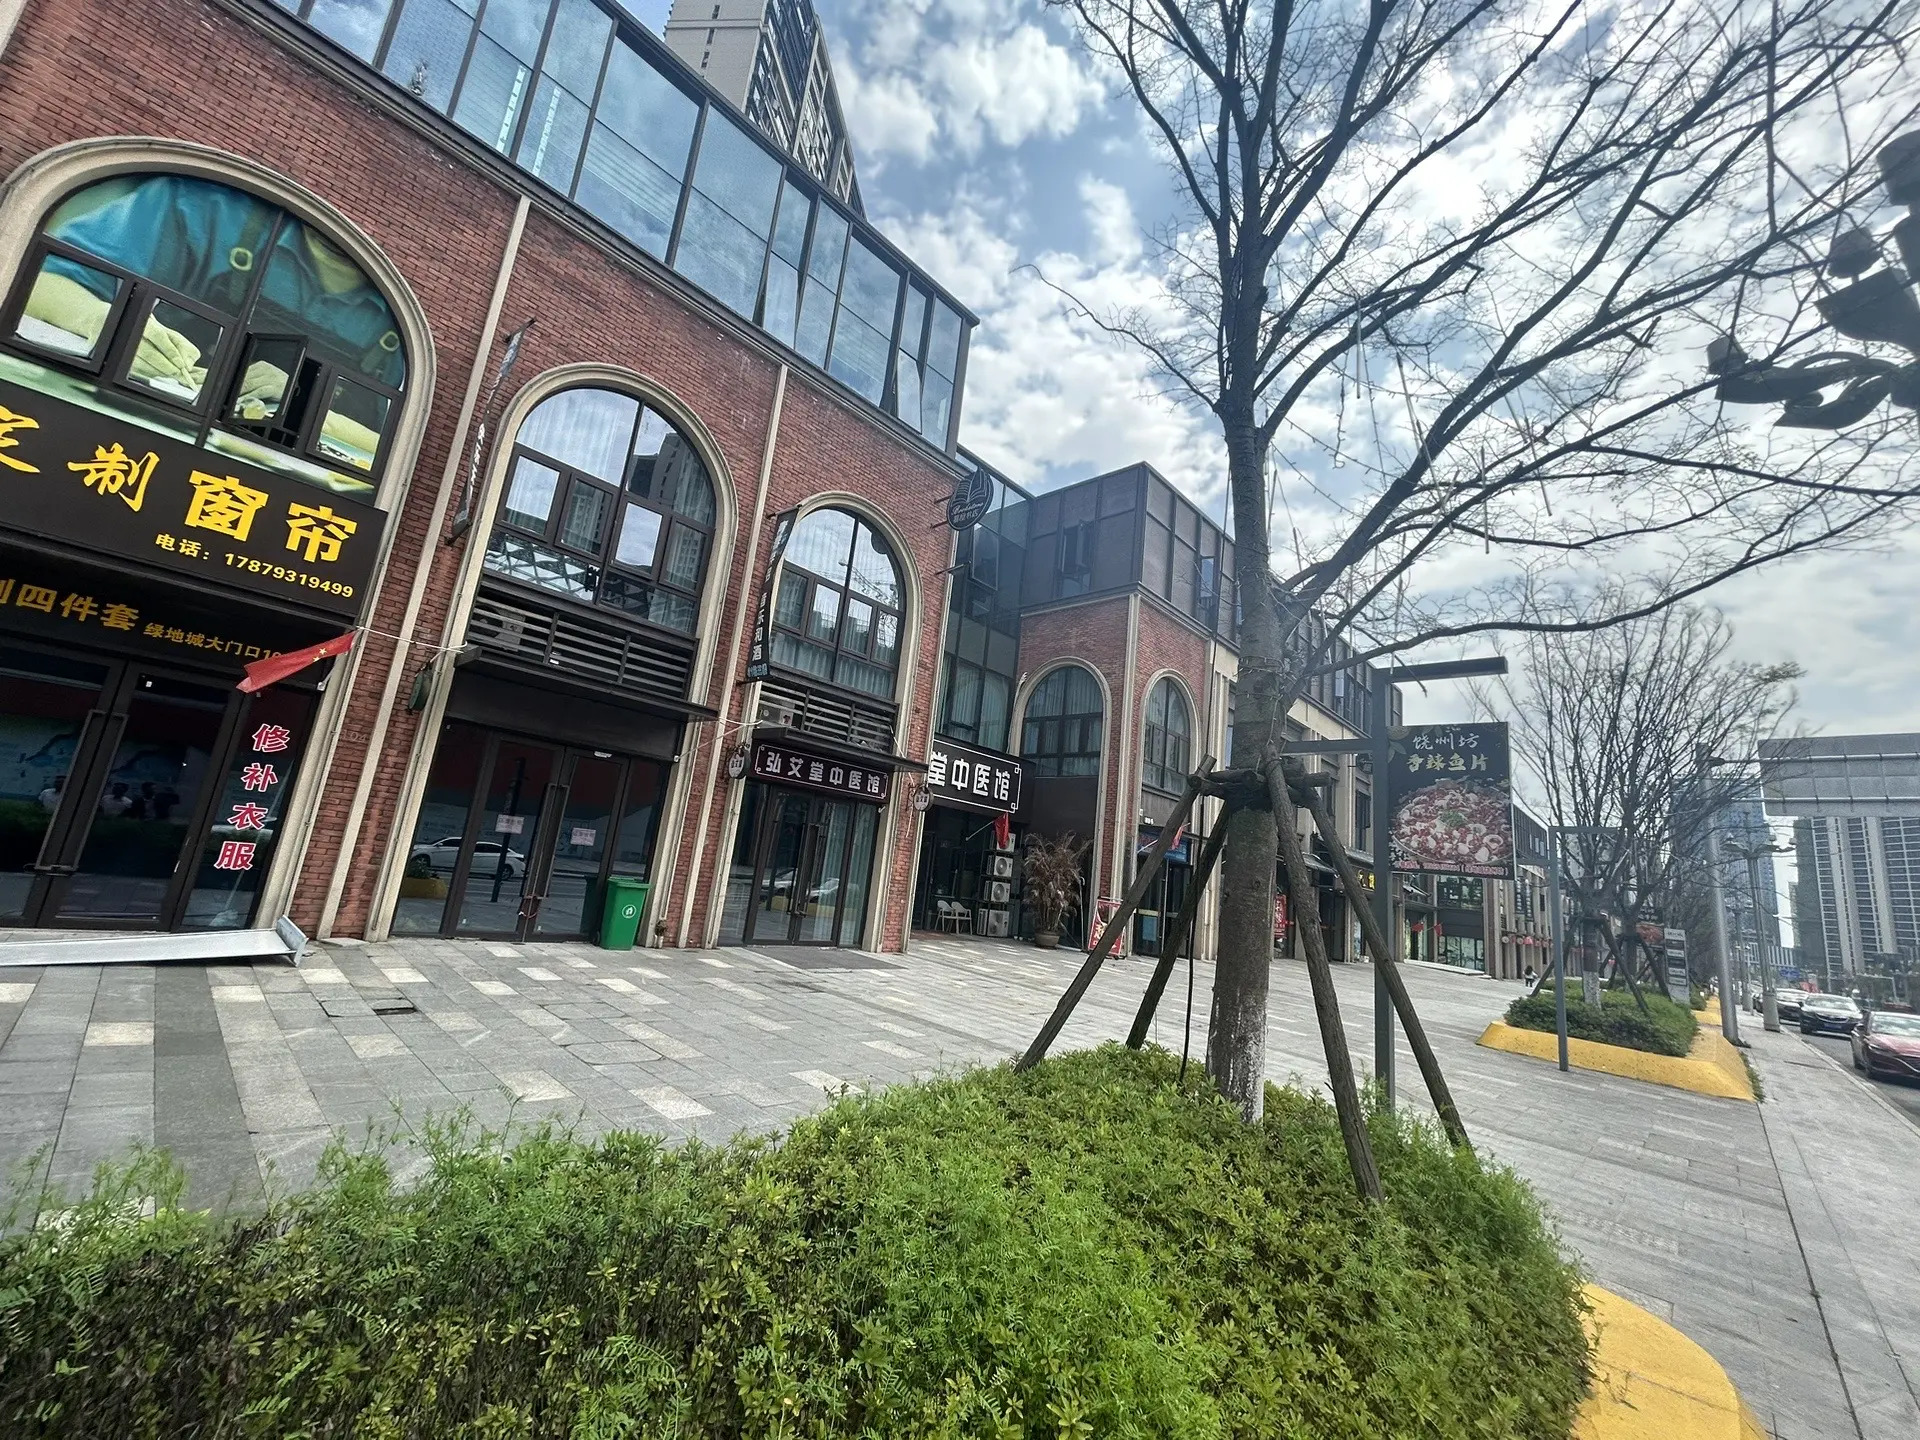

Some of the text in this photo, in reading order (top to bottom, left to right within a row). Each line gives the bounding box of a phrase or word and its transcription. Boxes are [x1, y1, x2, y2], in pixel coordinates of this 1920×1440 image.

[214, 723, 290, 871] 修补衣服
[766, 751, 880, 793] 弘艾堂中医馆
[928, 751, 1010, 801] 堂中医馆
